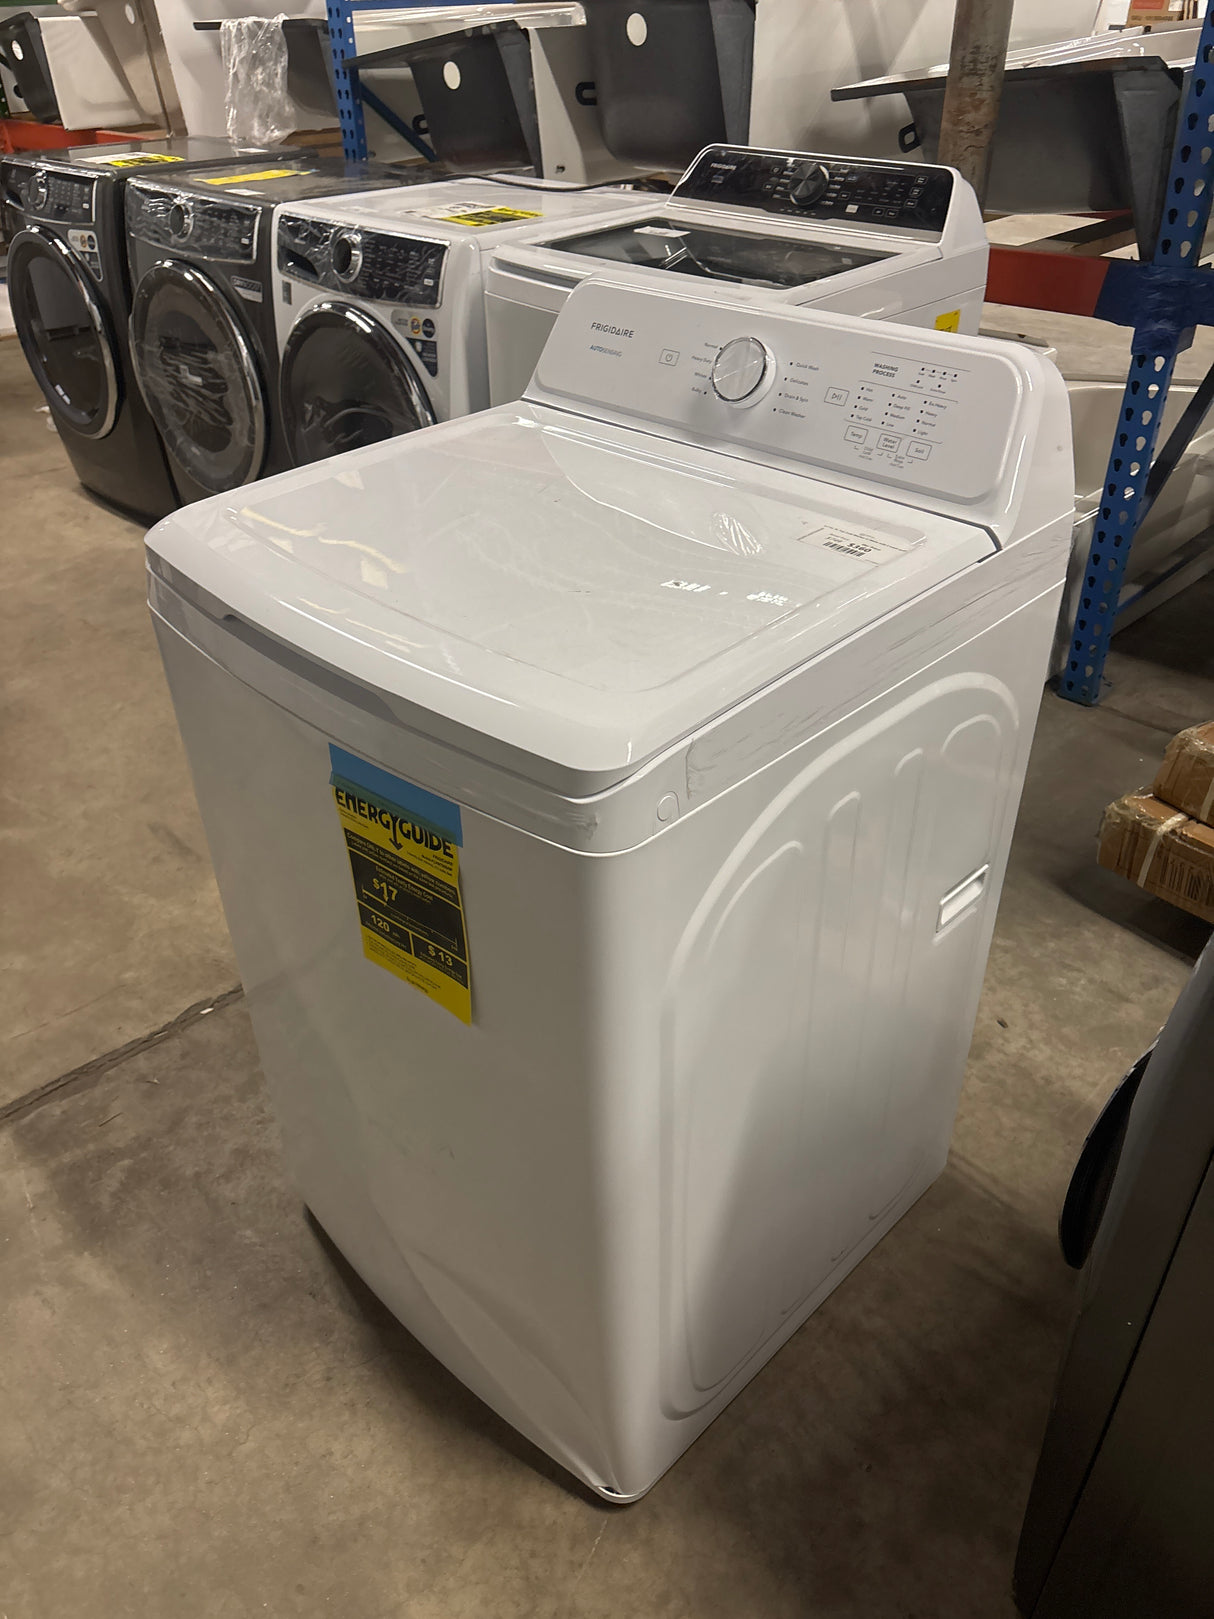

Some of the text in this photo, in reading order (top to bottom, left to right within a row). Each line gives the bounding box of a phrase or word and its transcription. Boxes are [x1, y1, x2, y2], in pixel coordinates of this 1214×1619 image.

[590, 321, 635, 338] FRIGIDAIRE
[871, 368, 896, 378] PROCESS
[873, 362, 899, 373] WASHING
[335, 786, 454, 859] ENERGYGUIDE
[372, 877, 398, 903] $17
[370, 914, 390, 933] 120
